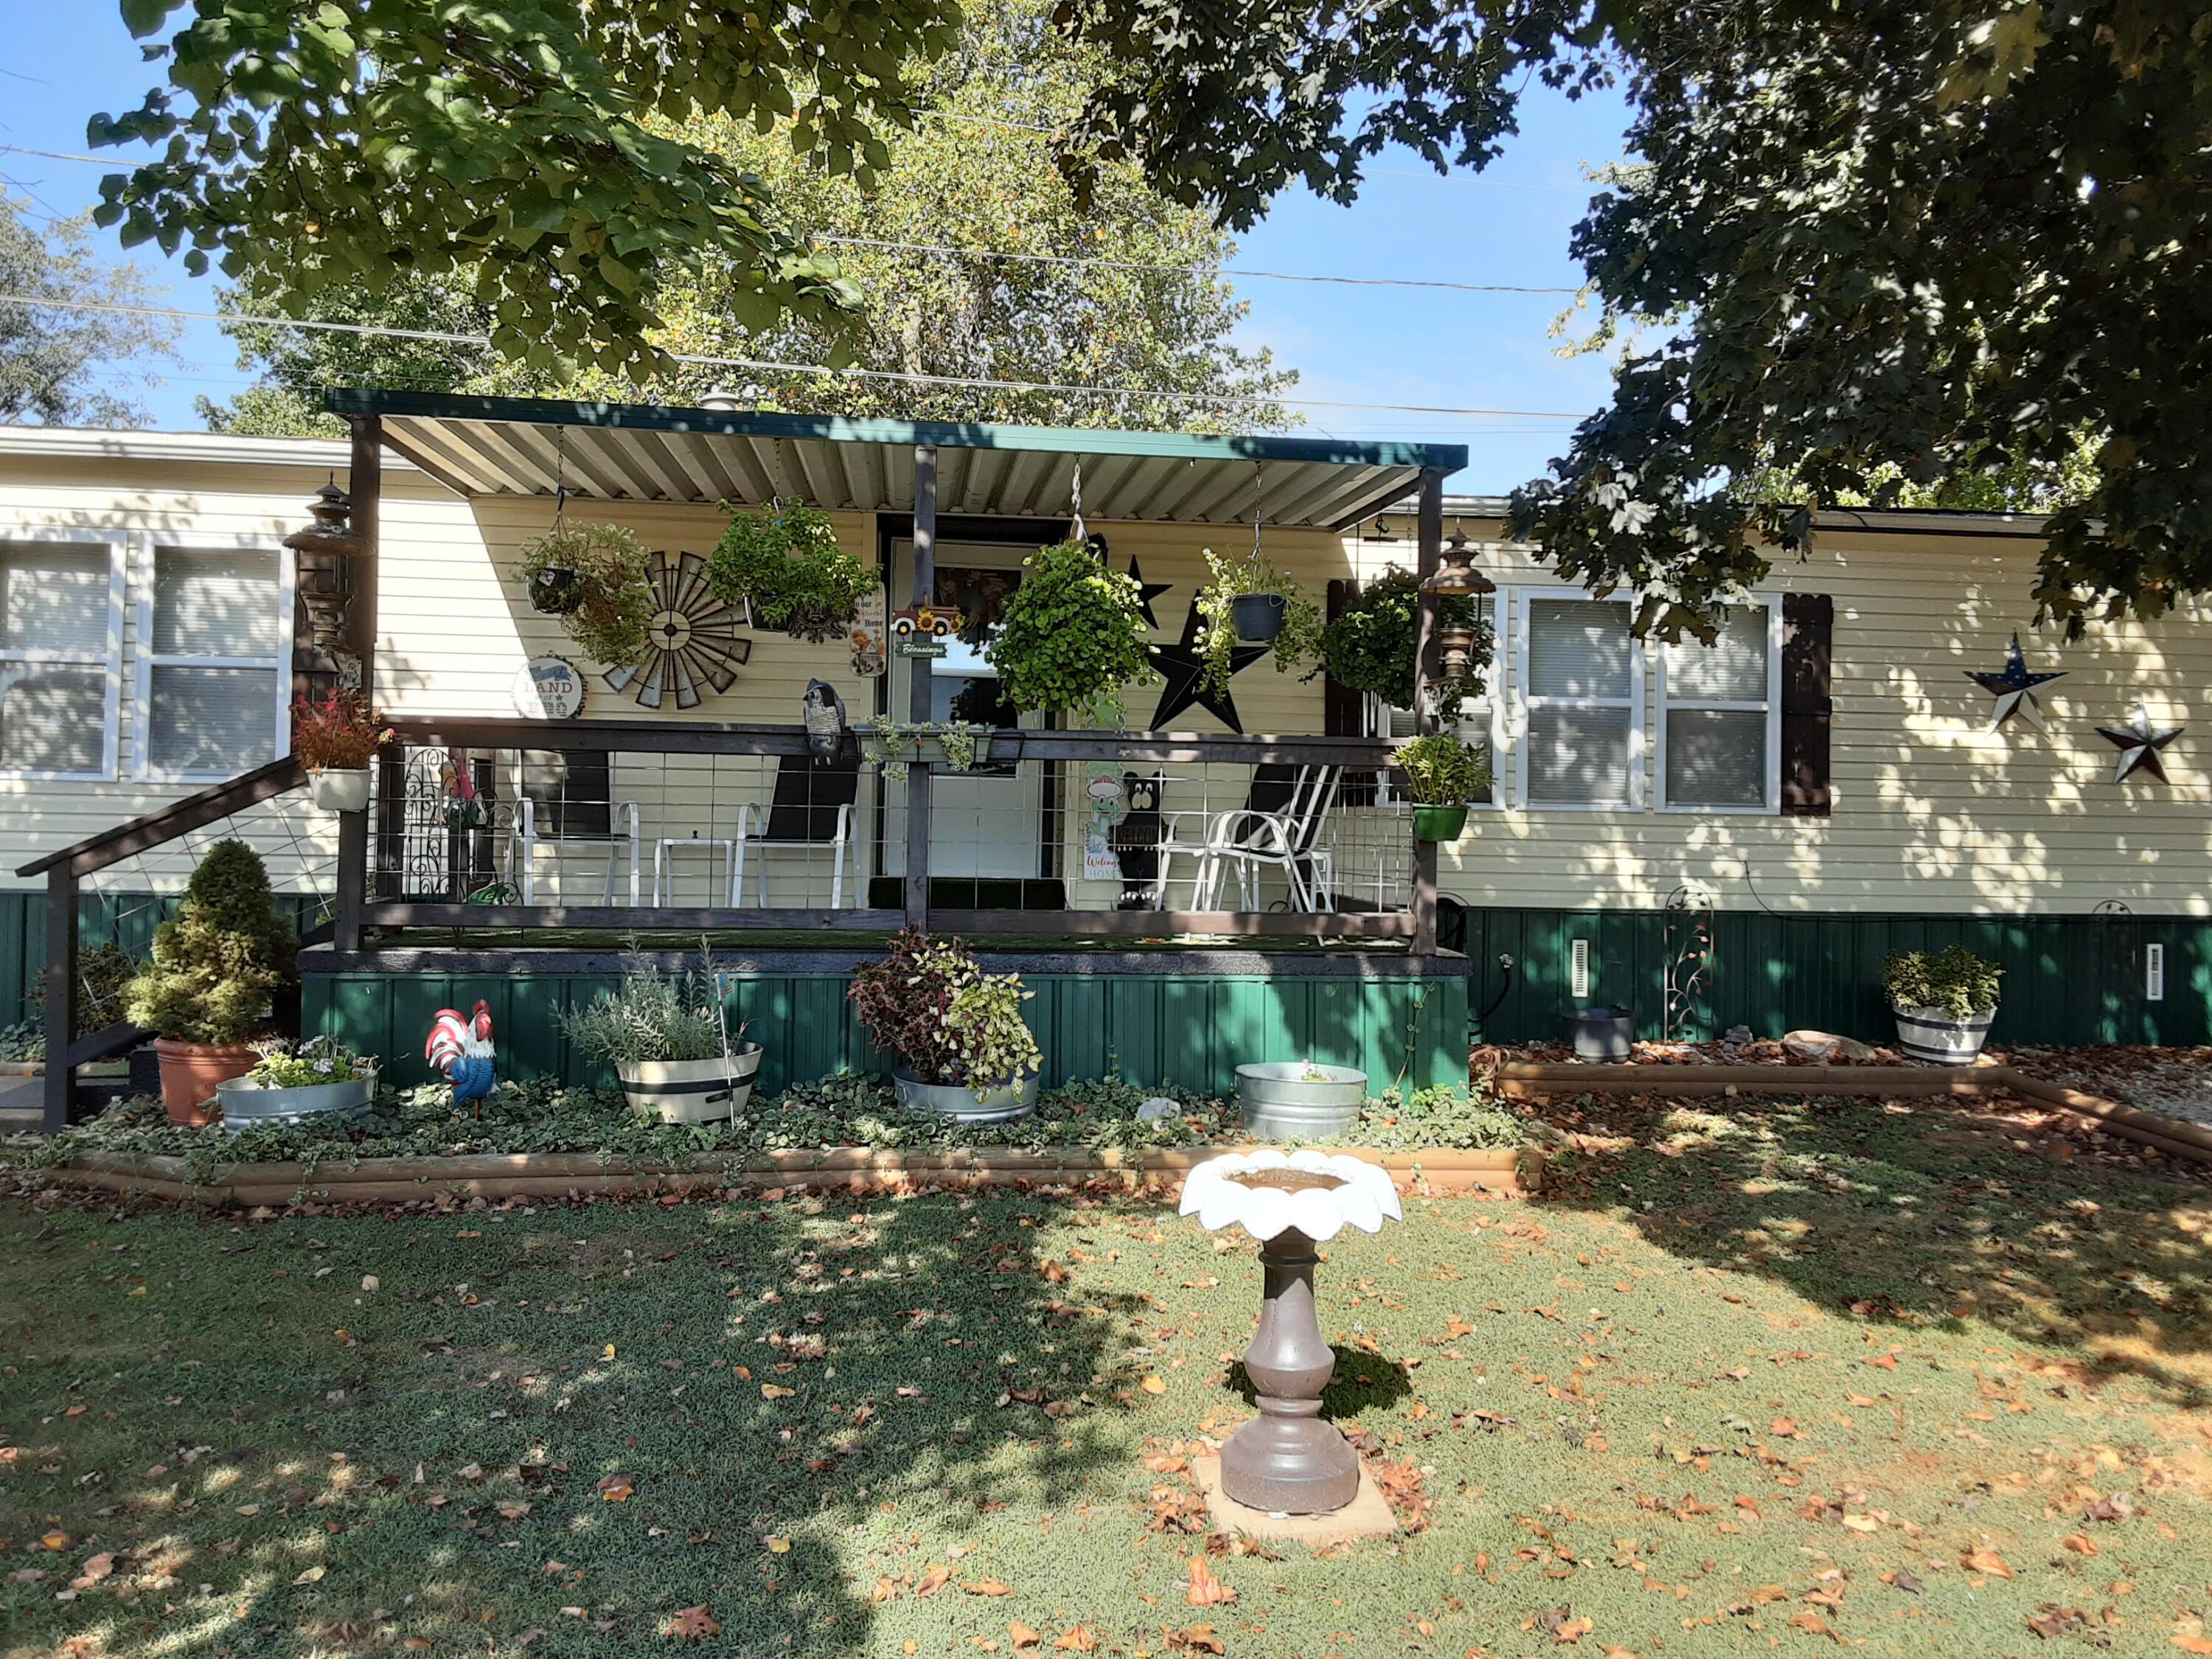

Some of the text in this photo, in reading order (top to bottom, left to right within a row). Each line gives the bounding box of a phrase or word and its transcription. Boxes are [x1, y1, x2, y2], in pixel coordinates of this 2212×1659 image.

[865, 619, 883, 627] Home
[902, 643, 944, 656] Blessings
[524, 681, 573, 693] LAND
